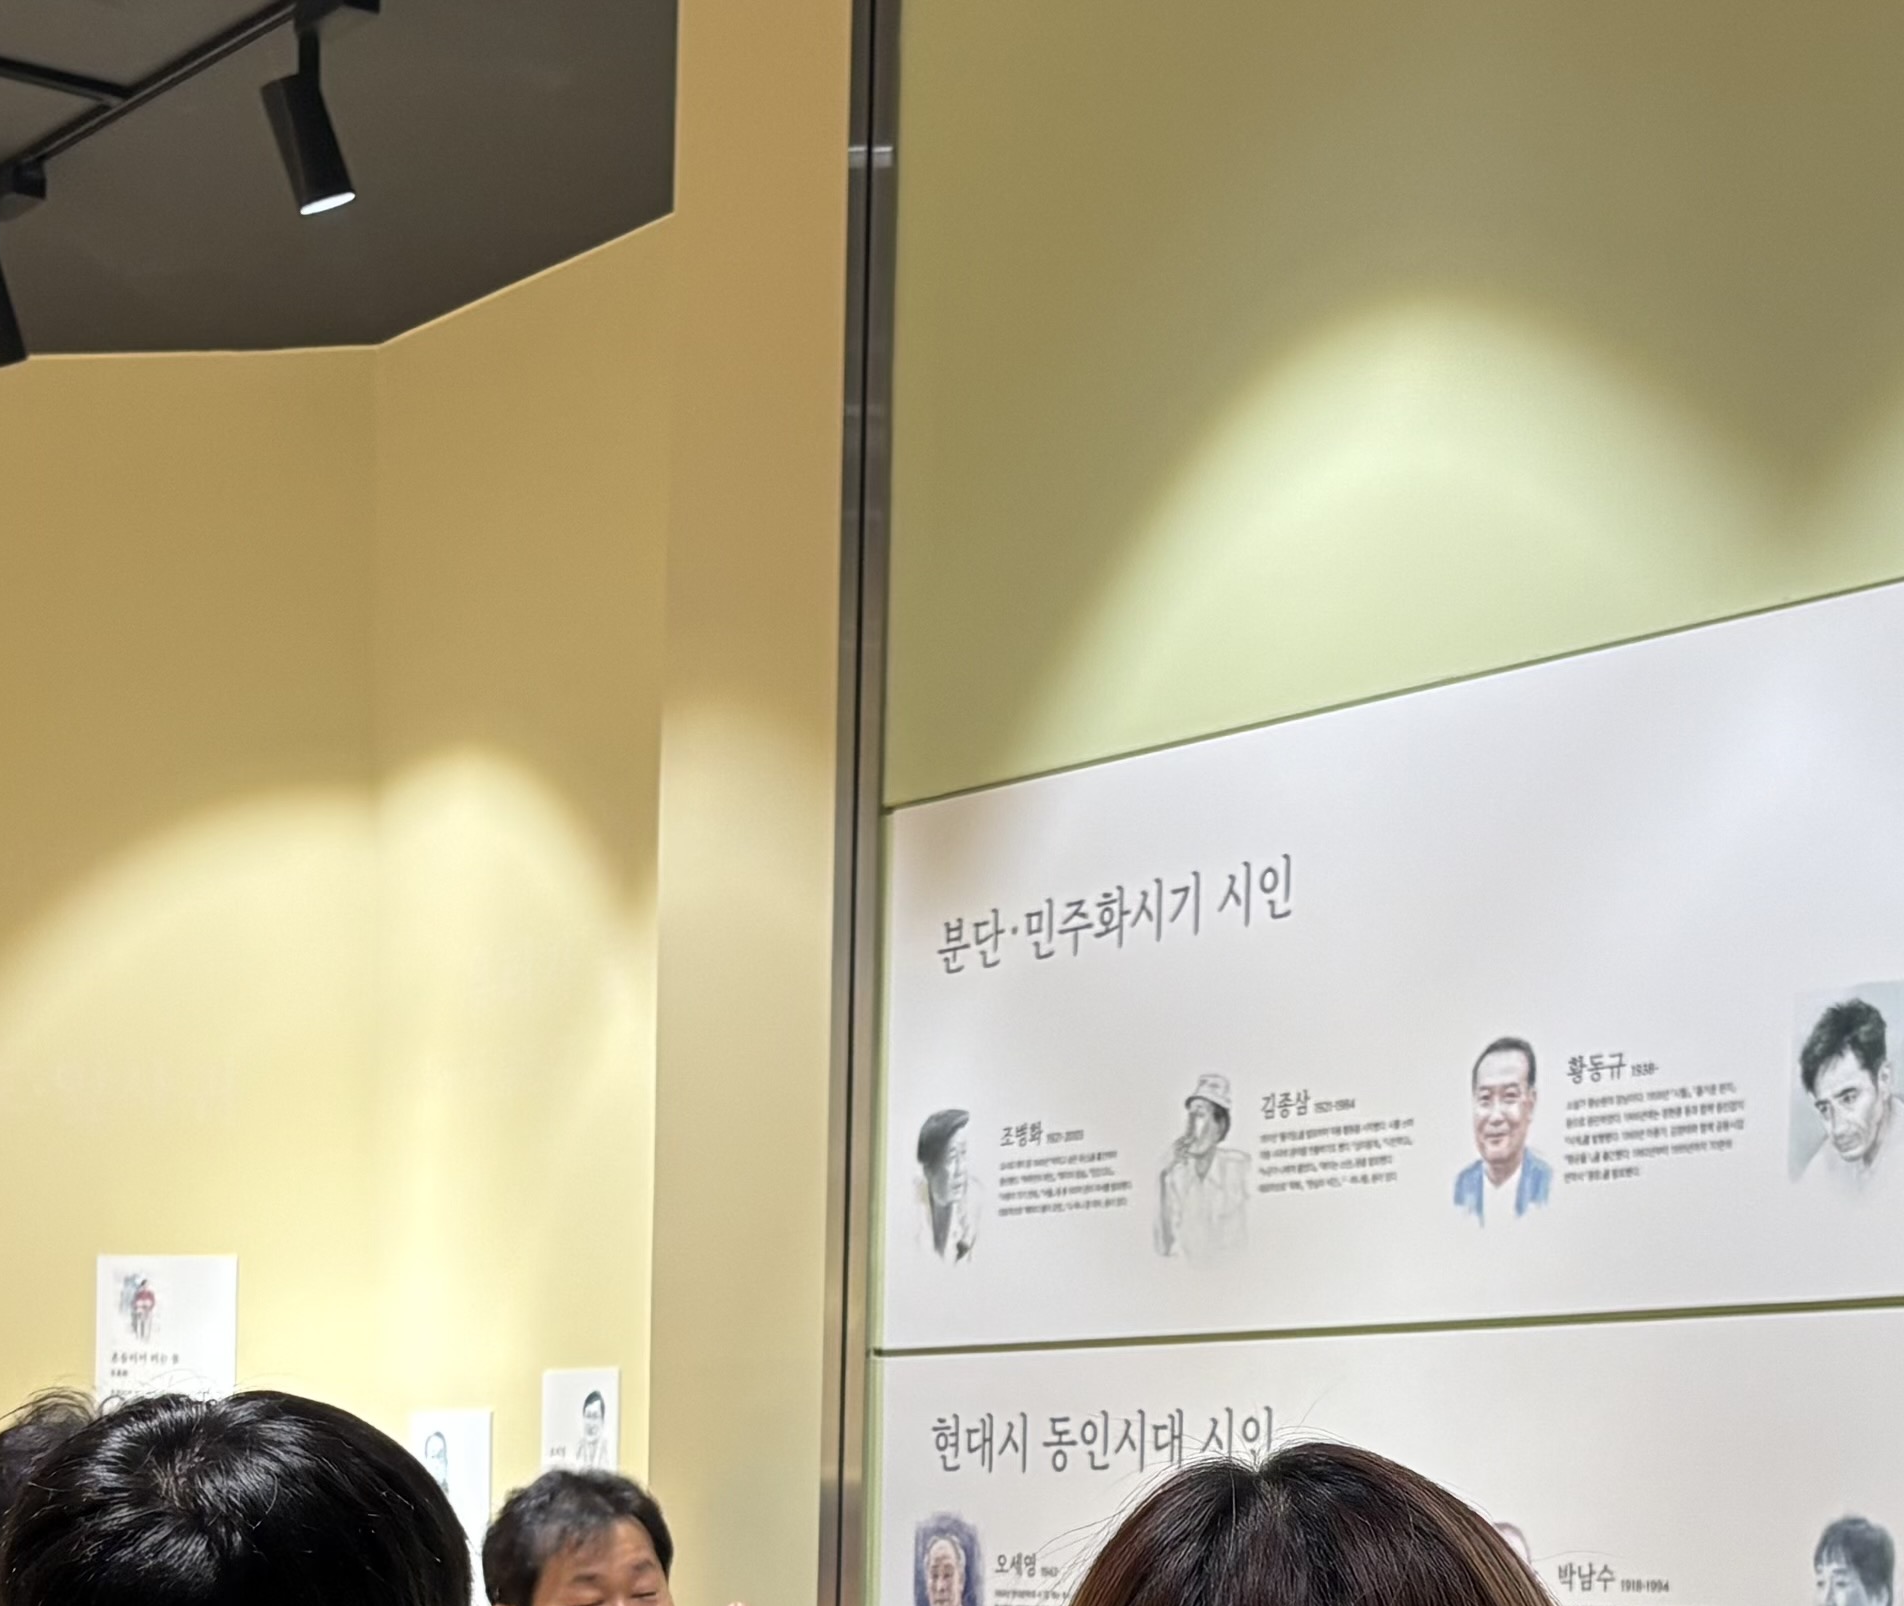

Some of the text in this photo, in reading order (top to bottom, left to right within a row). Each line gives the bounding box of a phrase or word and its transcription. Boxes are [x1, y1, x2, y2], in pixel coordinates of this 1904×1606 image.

[937, 853, 1293, 975] 분단·민주화시기 시인
[1566, 1052, 1627, 1084] 황동규
[1261, 1089, 1311, 1120] 김종삼
[1000, 1120, 1043, 1148] 조병화
[931, 1411, 1029, 1474] 현대시
[1042, 1408, 1185, 1473] 동인시대
[1558, 1562, 1669, 1592] 박남수 1918-1994
